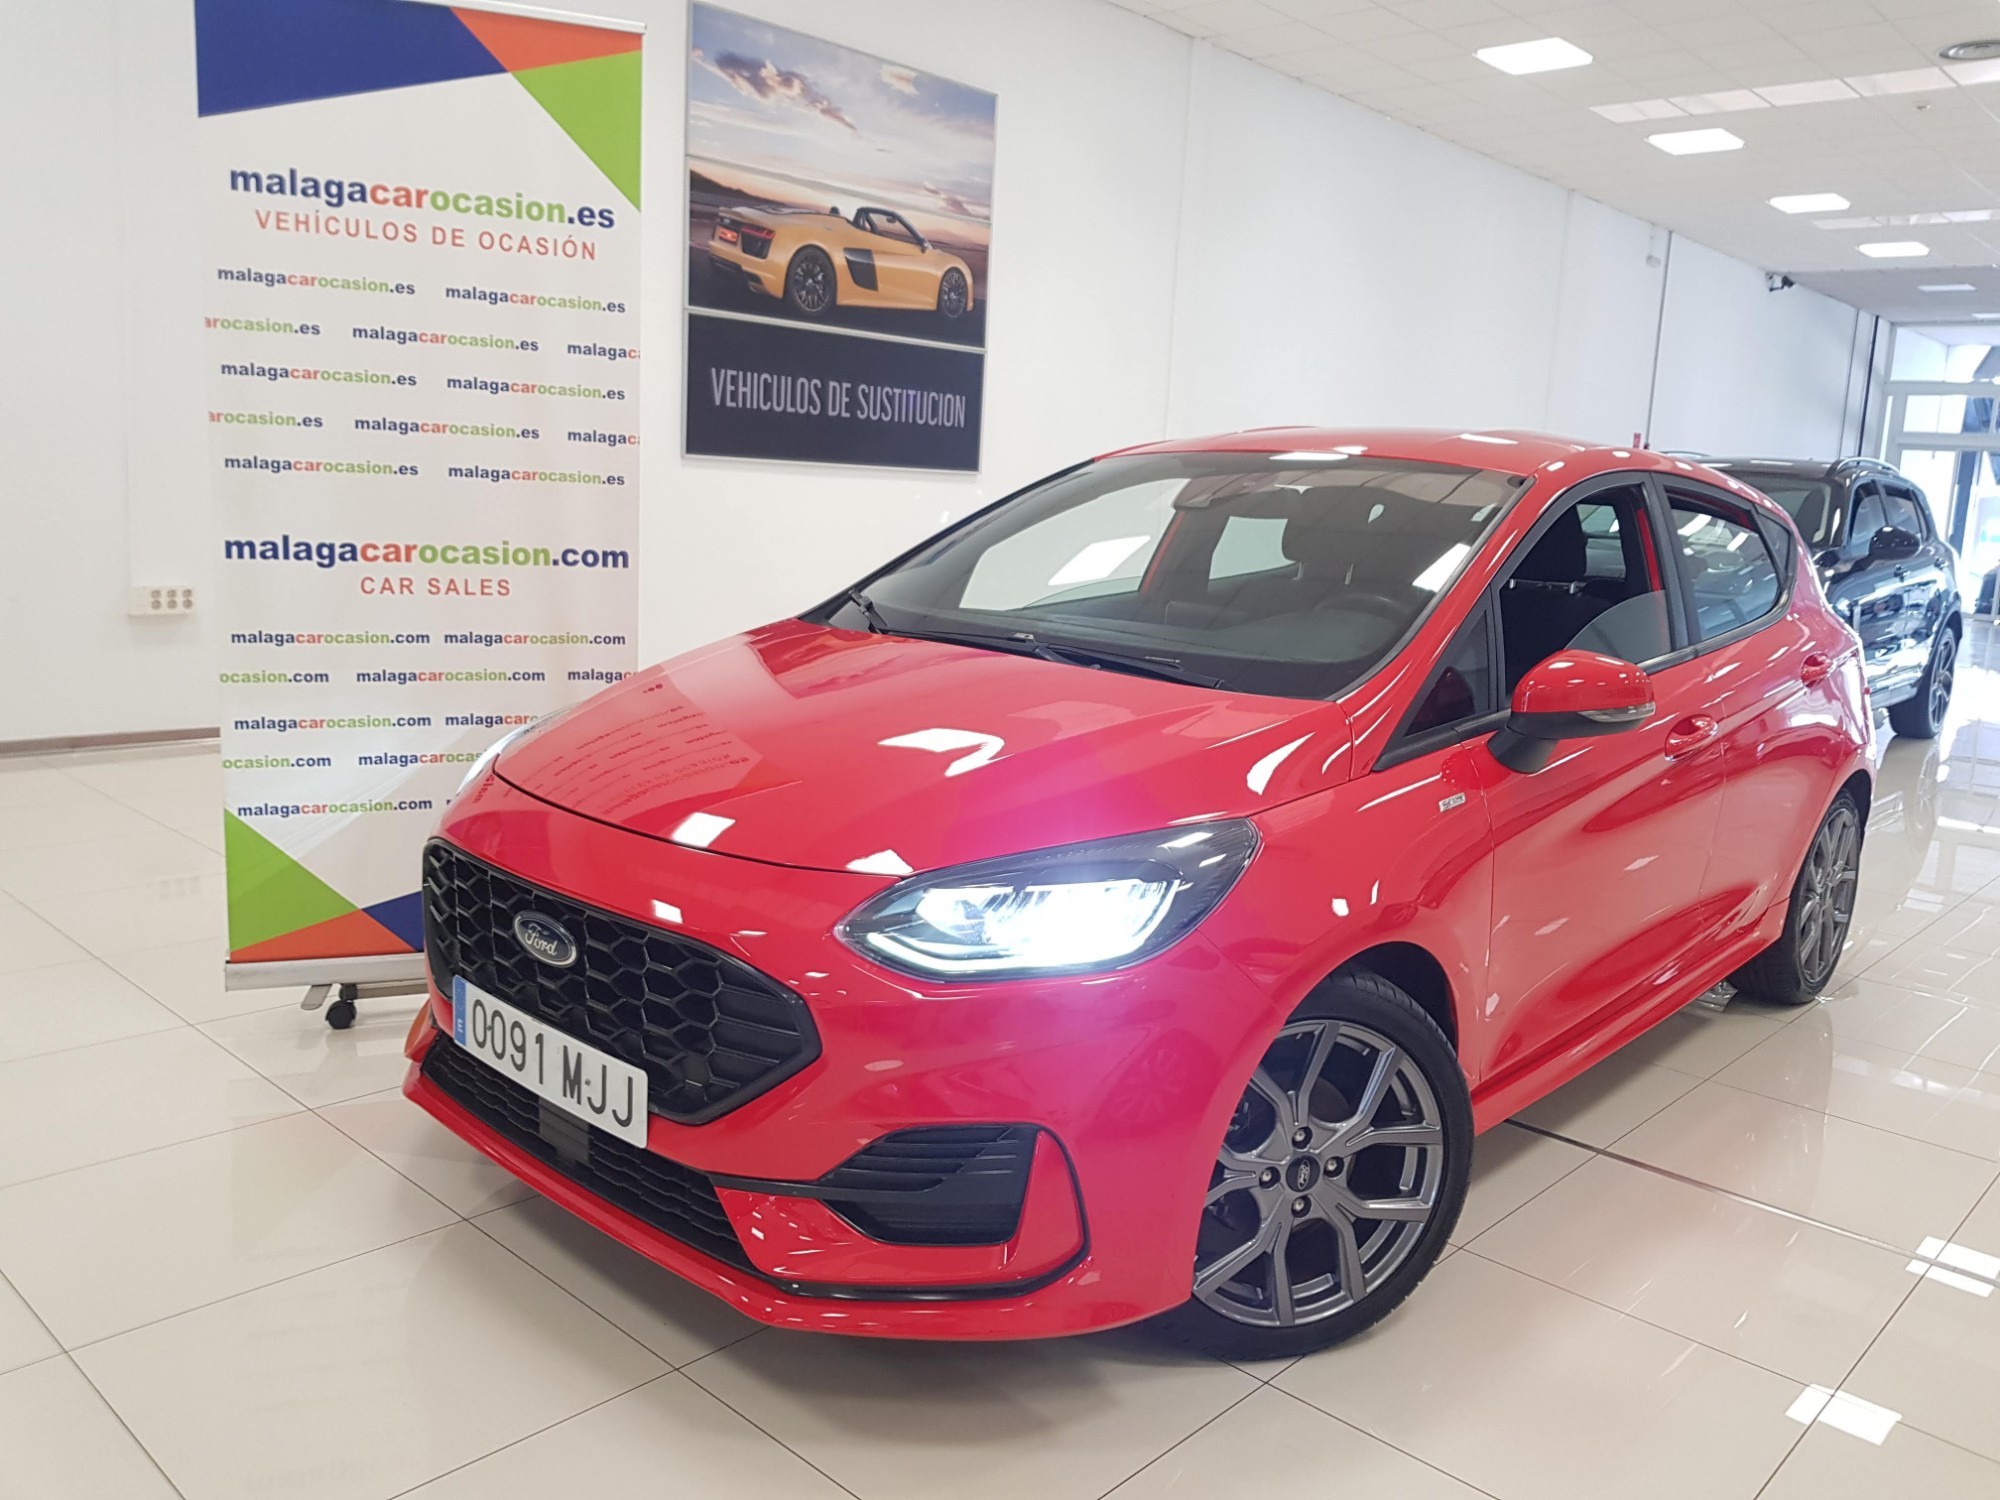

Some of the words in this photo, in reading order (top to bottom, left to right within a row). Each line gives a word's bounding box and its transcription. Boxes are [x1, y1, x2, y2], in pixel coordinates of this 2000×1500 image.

[229, 167, 616, 229] malagacarocasion.es
[255, 208, 418, 243] VEHÍCULOS
[432, 226, 464, 247] DE
[478, 233, 597, 261] OCASIÓN
[218, 268, 415, 295] malagacarocasion.es
[446, 287, 625, 313] malagacarocasion.es
[353, 326, 539, 351] malagacarocasion.es
[221, 363, 417, 386] malagacarocasion.es
[447, 377, 625, 400] malagacarocasion.es
[711, 367, 821, 415] VEHICULOS
[828, 381, 851, 418] DE
[856, 384, 966, 428] SUSTITUCION
[355, 417, 539, 439] malagacarocasion.es
[225, 456, 418, 475] malagacarocasion.es
[449, 465, 624, 485] malagacarocasion.es
[225, 534, 629, 568] malagacarocasion.com
[361, 577, 413, 594] CAR
[428, 578, 509, 596] SALES
[231, 630, 430, 647] malagacarocasion.com
[444, 630, 625, 647] malagacarocasion.com
[220, 669, 329, 683] ocasion.com
[357, 669, 545, 685] malagacarocasion.com
[235, 715, 431, 732] malagacarocasion.com
[222, 755, 332, 769] ocasion.com
[237, 797, 433, 818] malagacarocasion.com
[525, 923, 558, 956] Ford
[472, 999, 544, 1085] 0091
